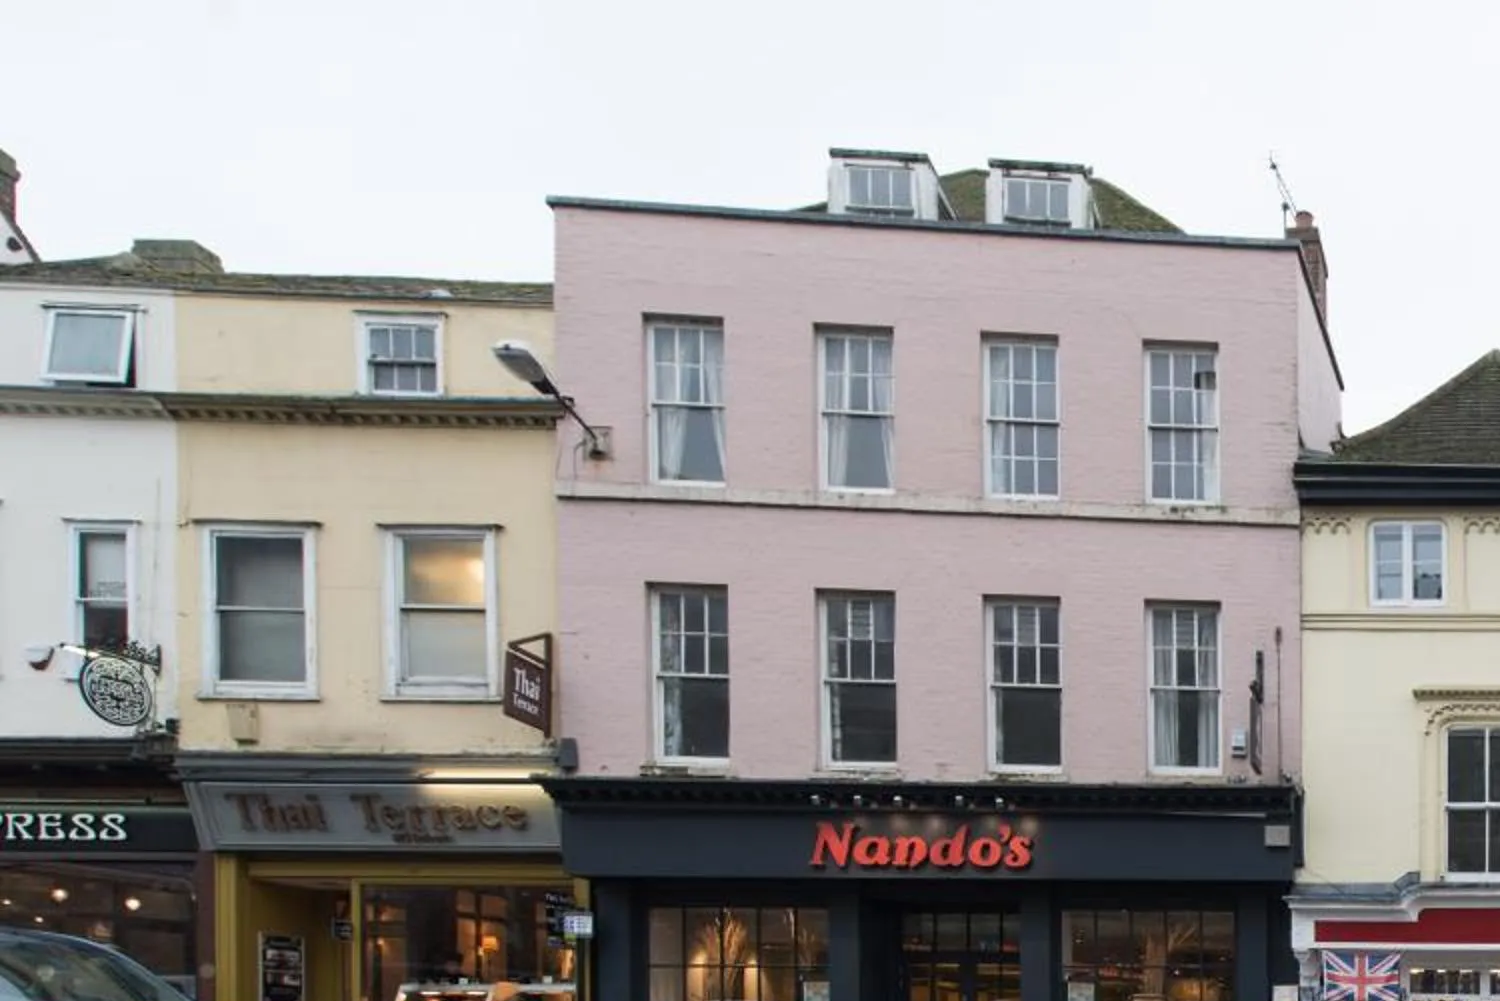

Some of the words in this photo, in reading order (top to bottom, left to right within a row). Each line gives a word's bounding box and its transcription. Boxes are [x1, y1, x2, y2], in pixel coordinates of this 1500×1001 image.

[512, 667, 541, 701] Thai
[0, 812, 128, 841] RESS
[225, 793, 329, 834] Thai
[350, 793, 531, 834] Terrace
[809, 821, 1033, 868] Nando's
